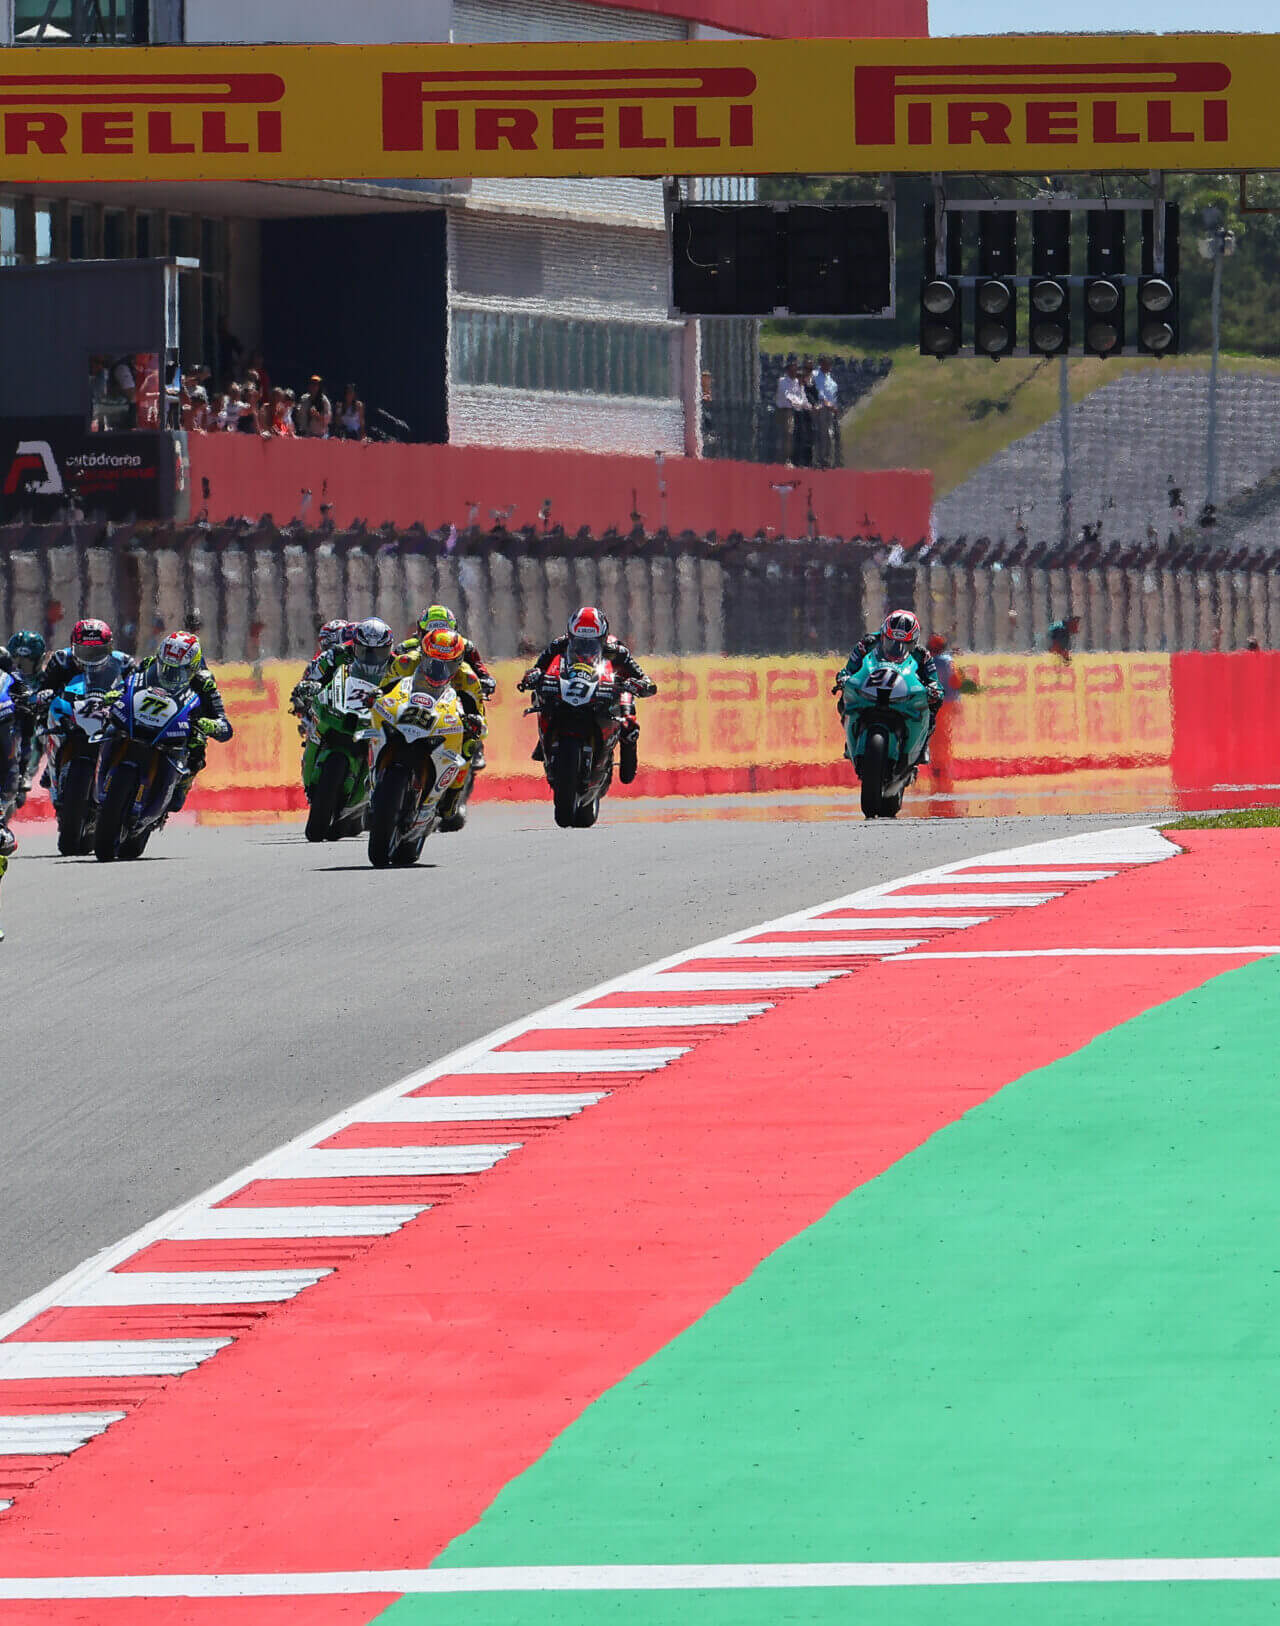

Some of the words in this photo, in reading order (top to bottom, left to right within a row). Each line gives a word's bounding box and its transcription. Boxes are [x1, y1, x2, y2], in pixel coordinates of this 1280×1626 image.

[381, 66, 757, 151] PIRELLI
[854, 61, 1232, 145] PIRELLI
[139, 696, 168, 716] 77
